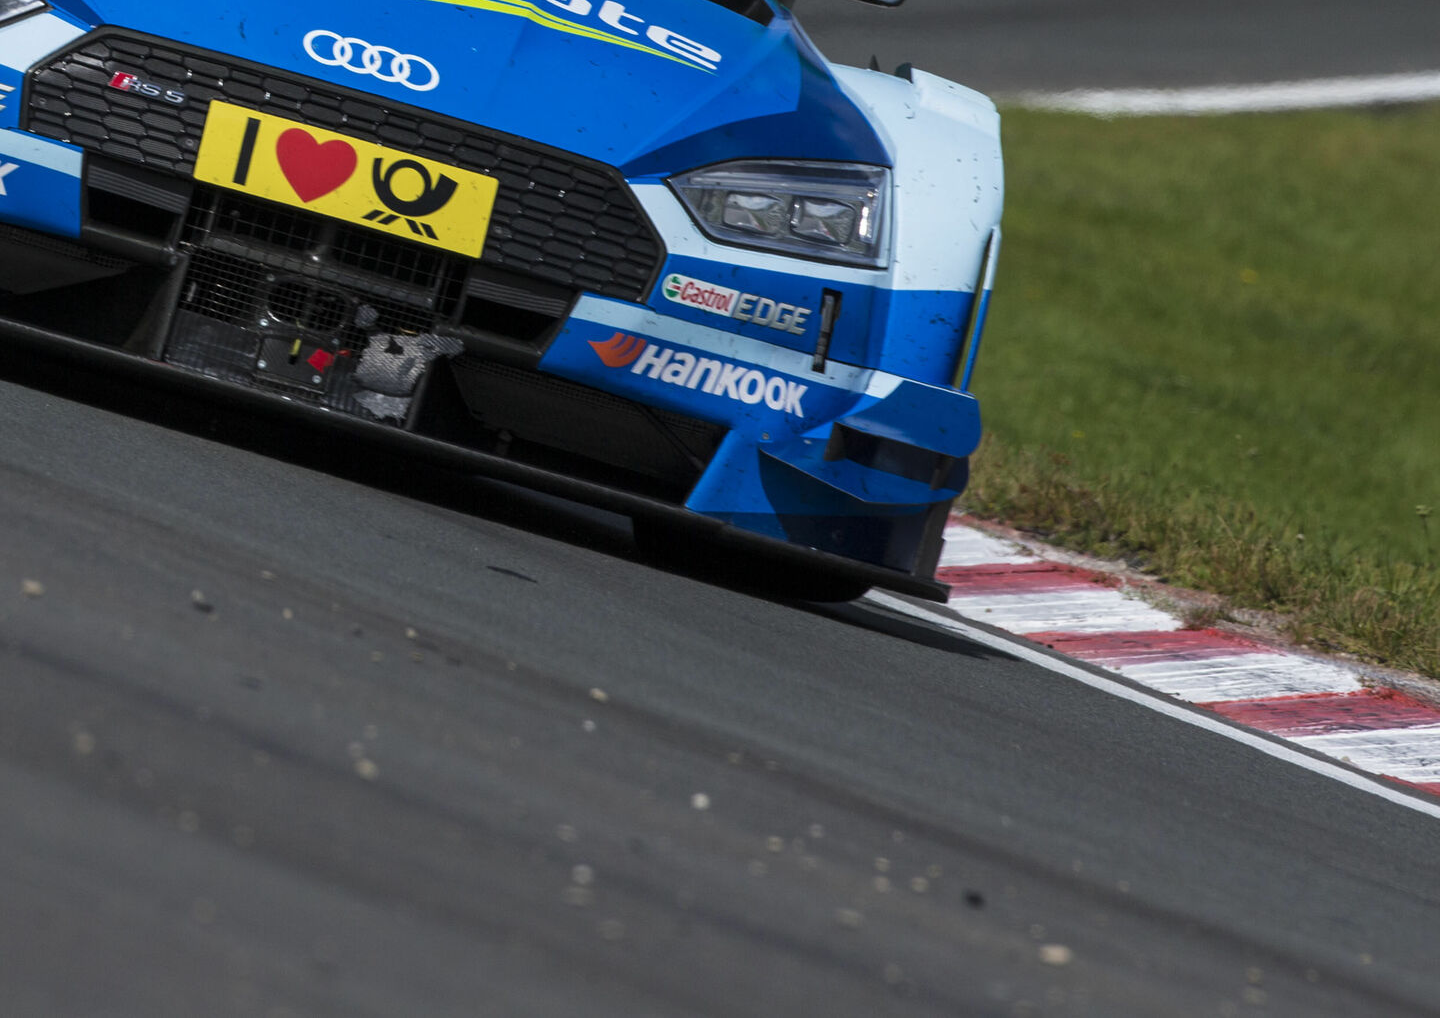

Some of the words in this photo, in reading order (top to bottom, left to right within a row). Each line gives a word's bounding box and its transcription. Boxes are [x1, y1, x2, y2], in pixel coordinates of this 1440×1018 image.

[232, 117, 262, 186] I
[680, 281, 735, 314] Castrol
[732, 292, 812, 336] EDGE
